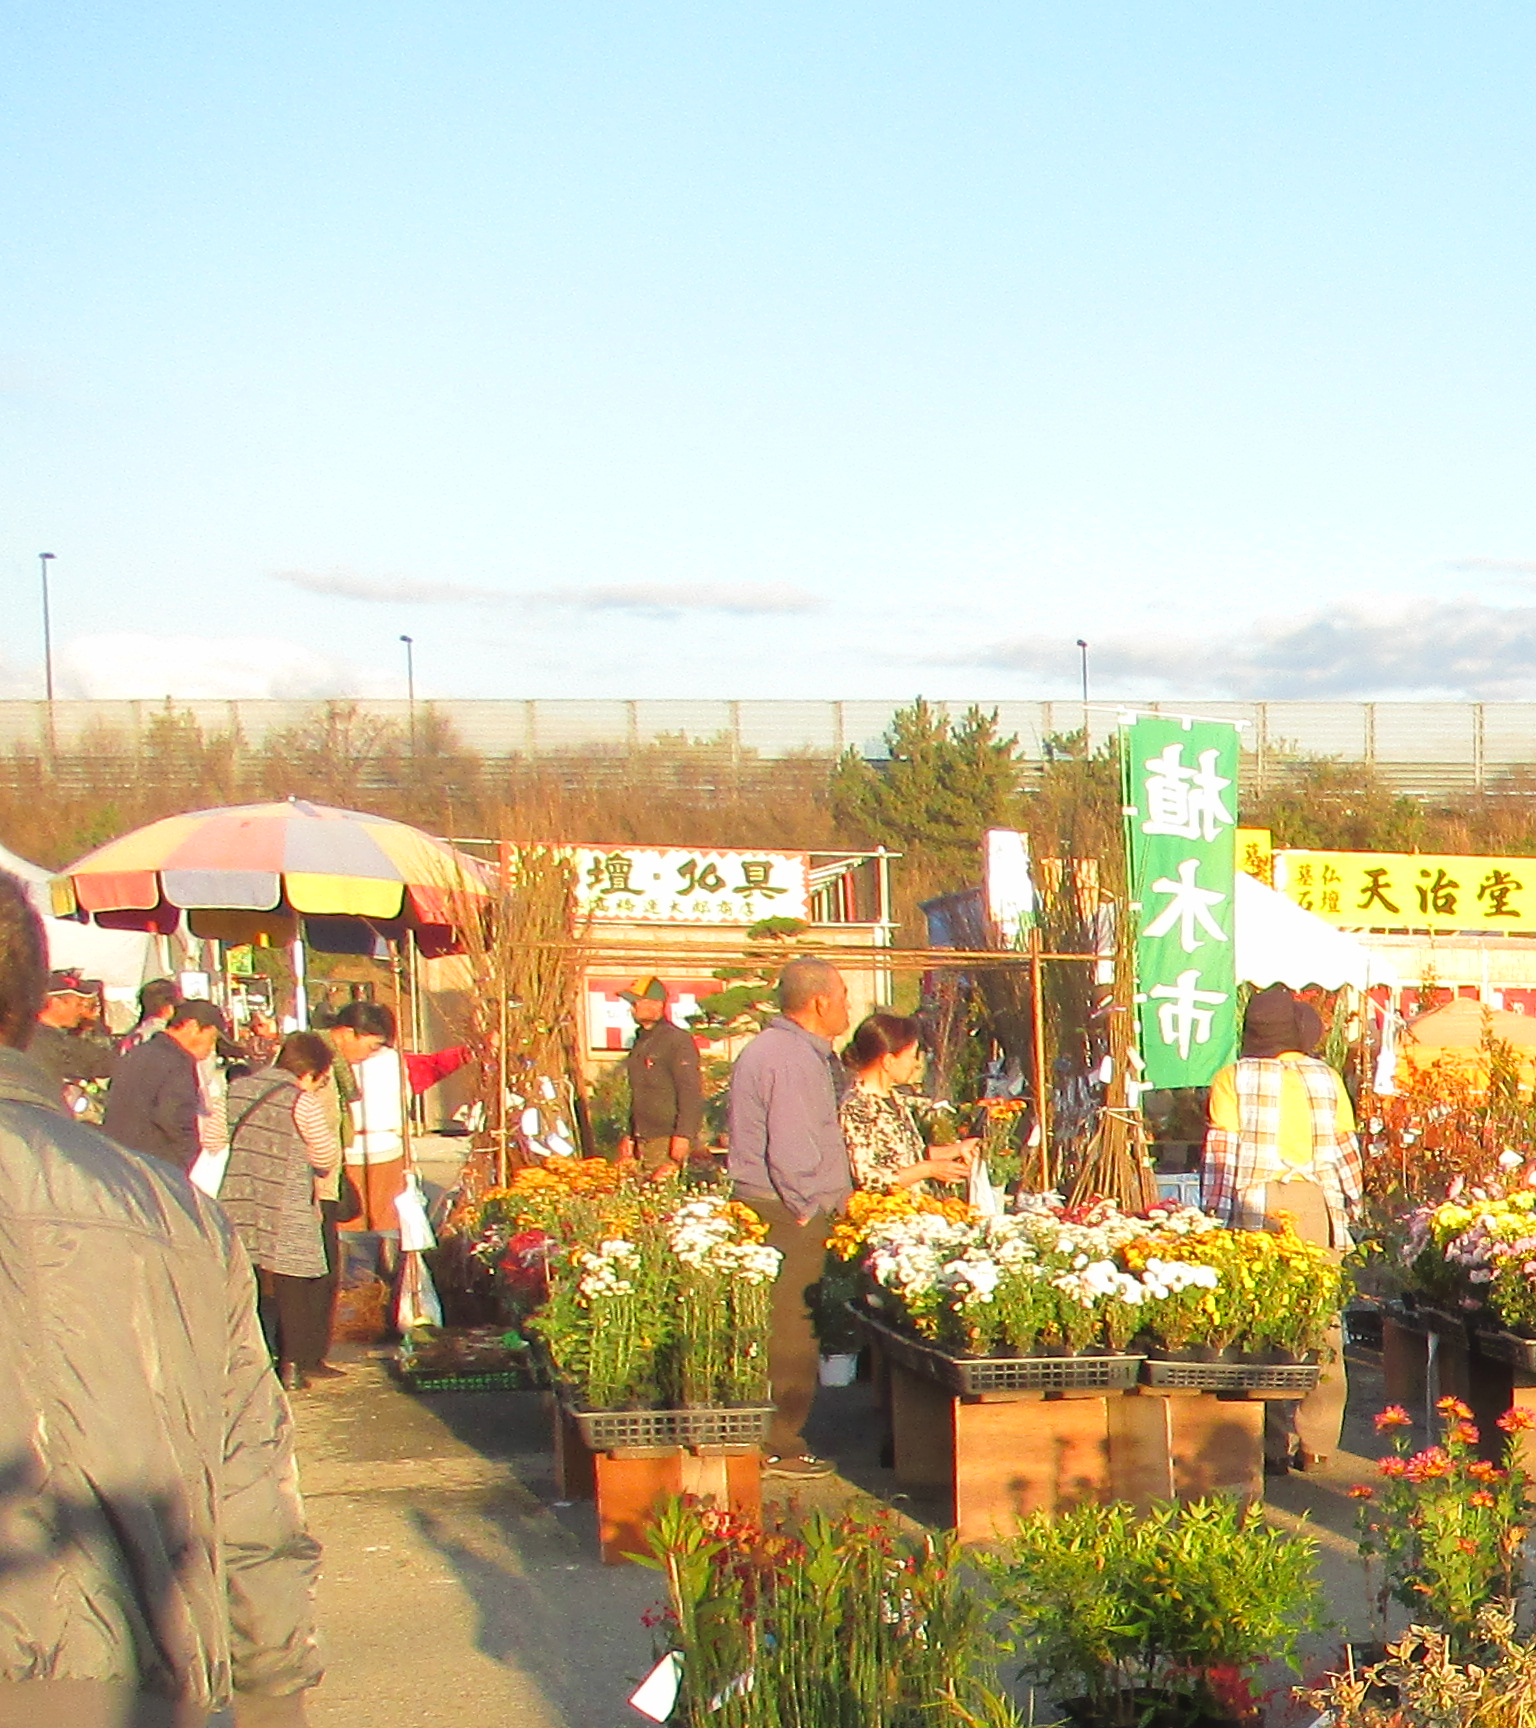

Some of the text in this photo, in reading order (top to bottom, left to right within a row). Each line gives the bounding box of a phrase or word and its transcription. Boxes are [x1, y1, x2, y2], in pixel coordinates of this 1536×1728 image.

[586, 853, 789, 900] 壇・仏具
[1321, 864, 1341, 913] 仏壇
[1357, 868, 1523, 917] 天治堂
